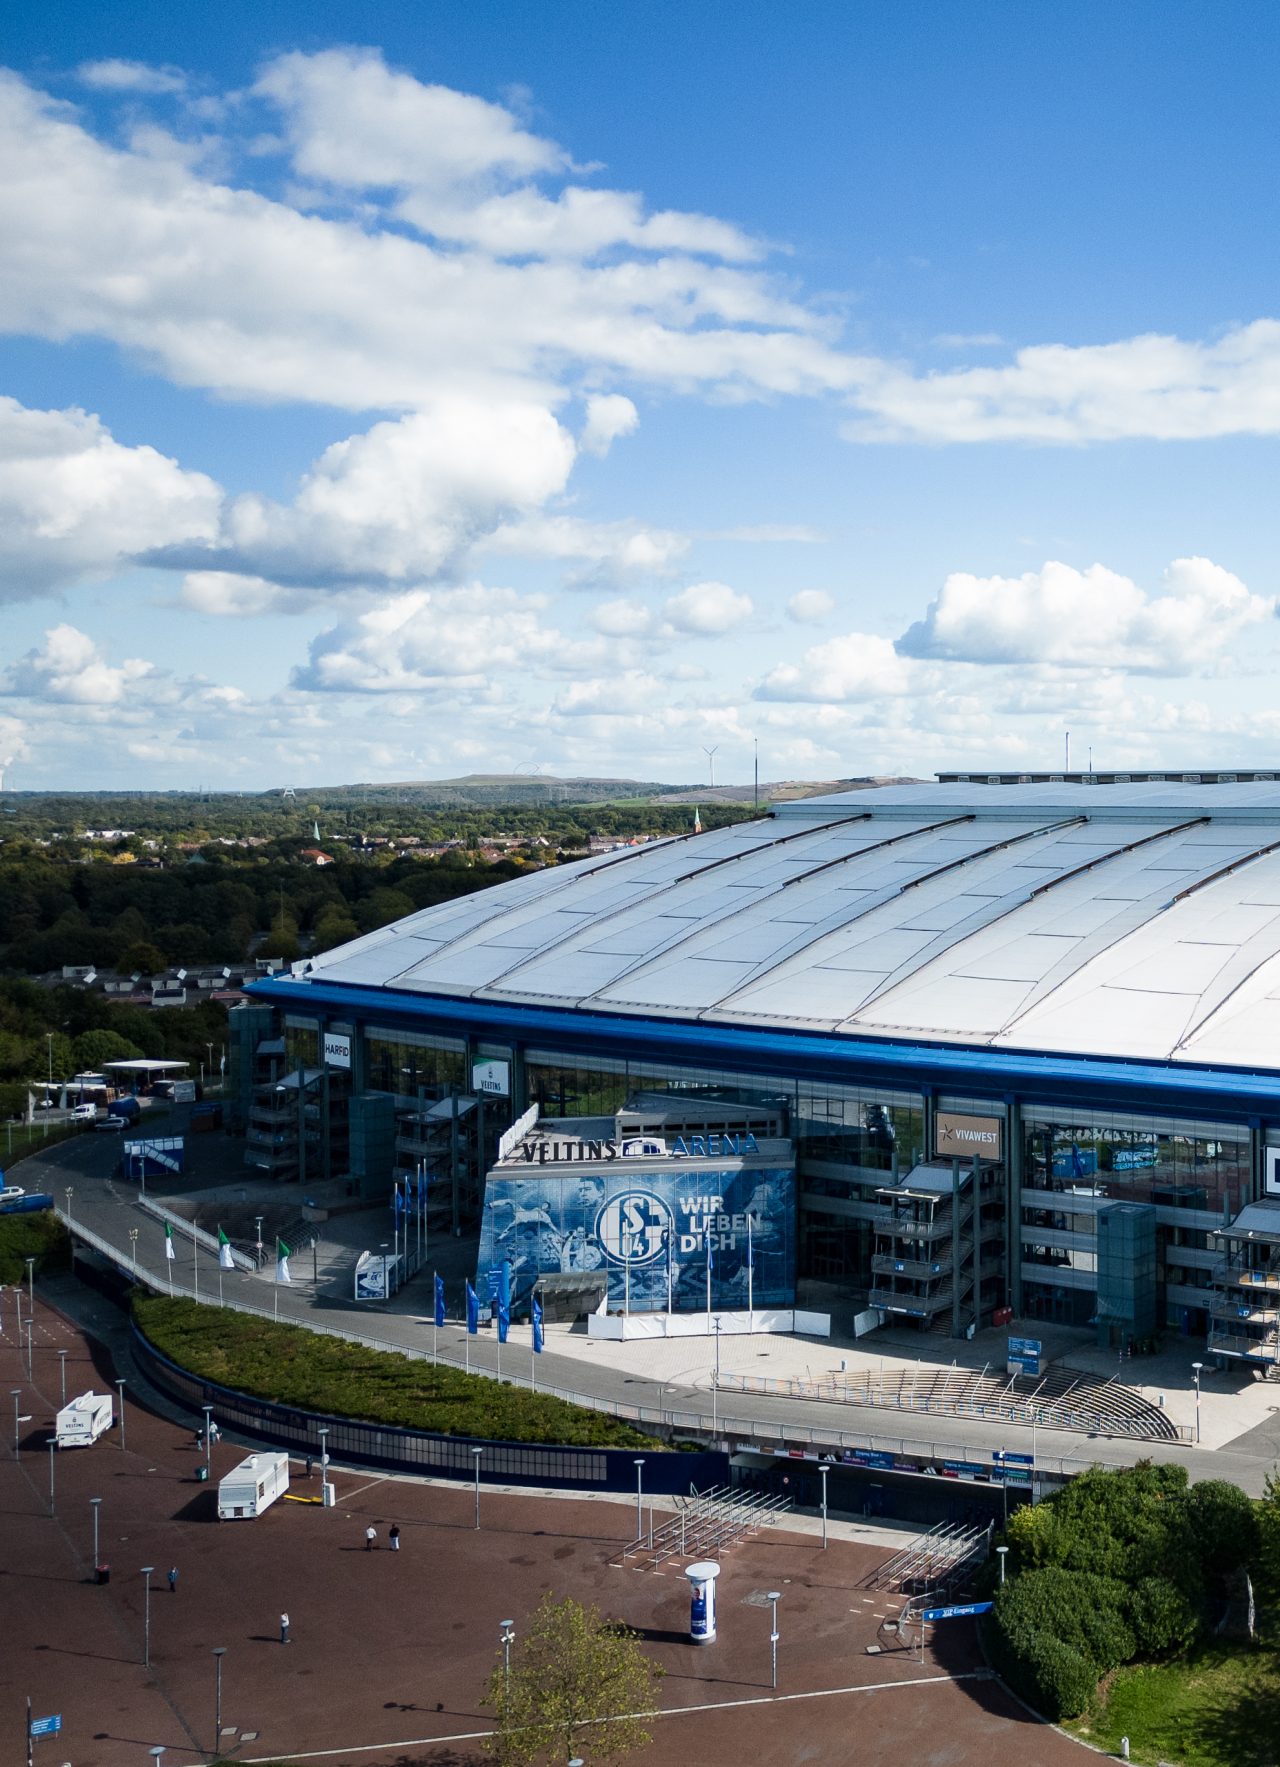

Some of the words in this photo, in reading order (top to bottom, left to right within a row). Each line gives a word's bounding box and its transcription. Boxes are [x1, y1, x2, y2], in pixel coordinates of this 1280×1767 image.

[955, 1128, 998, 1144] VIVAWEST
[522, 1139, 617, 1163] VELTINS
[672, 1132, 760, 1156] ARENA
[679, 1195, 724, 1214] WIR
[689, 1213, 761, 1233] LEBEN
[680, 1233, 736, 1252] DICH
